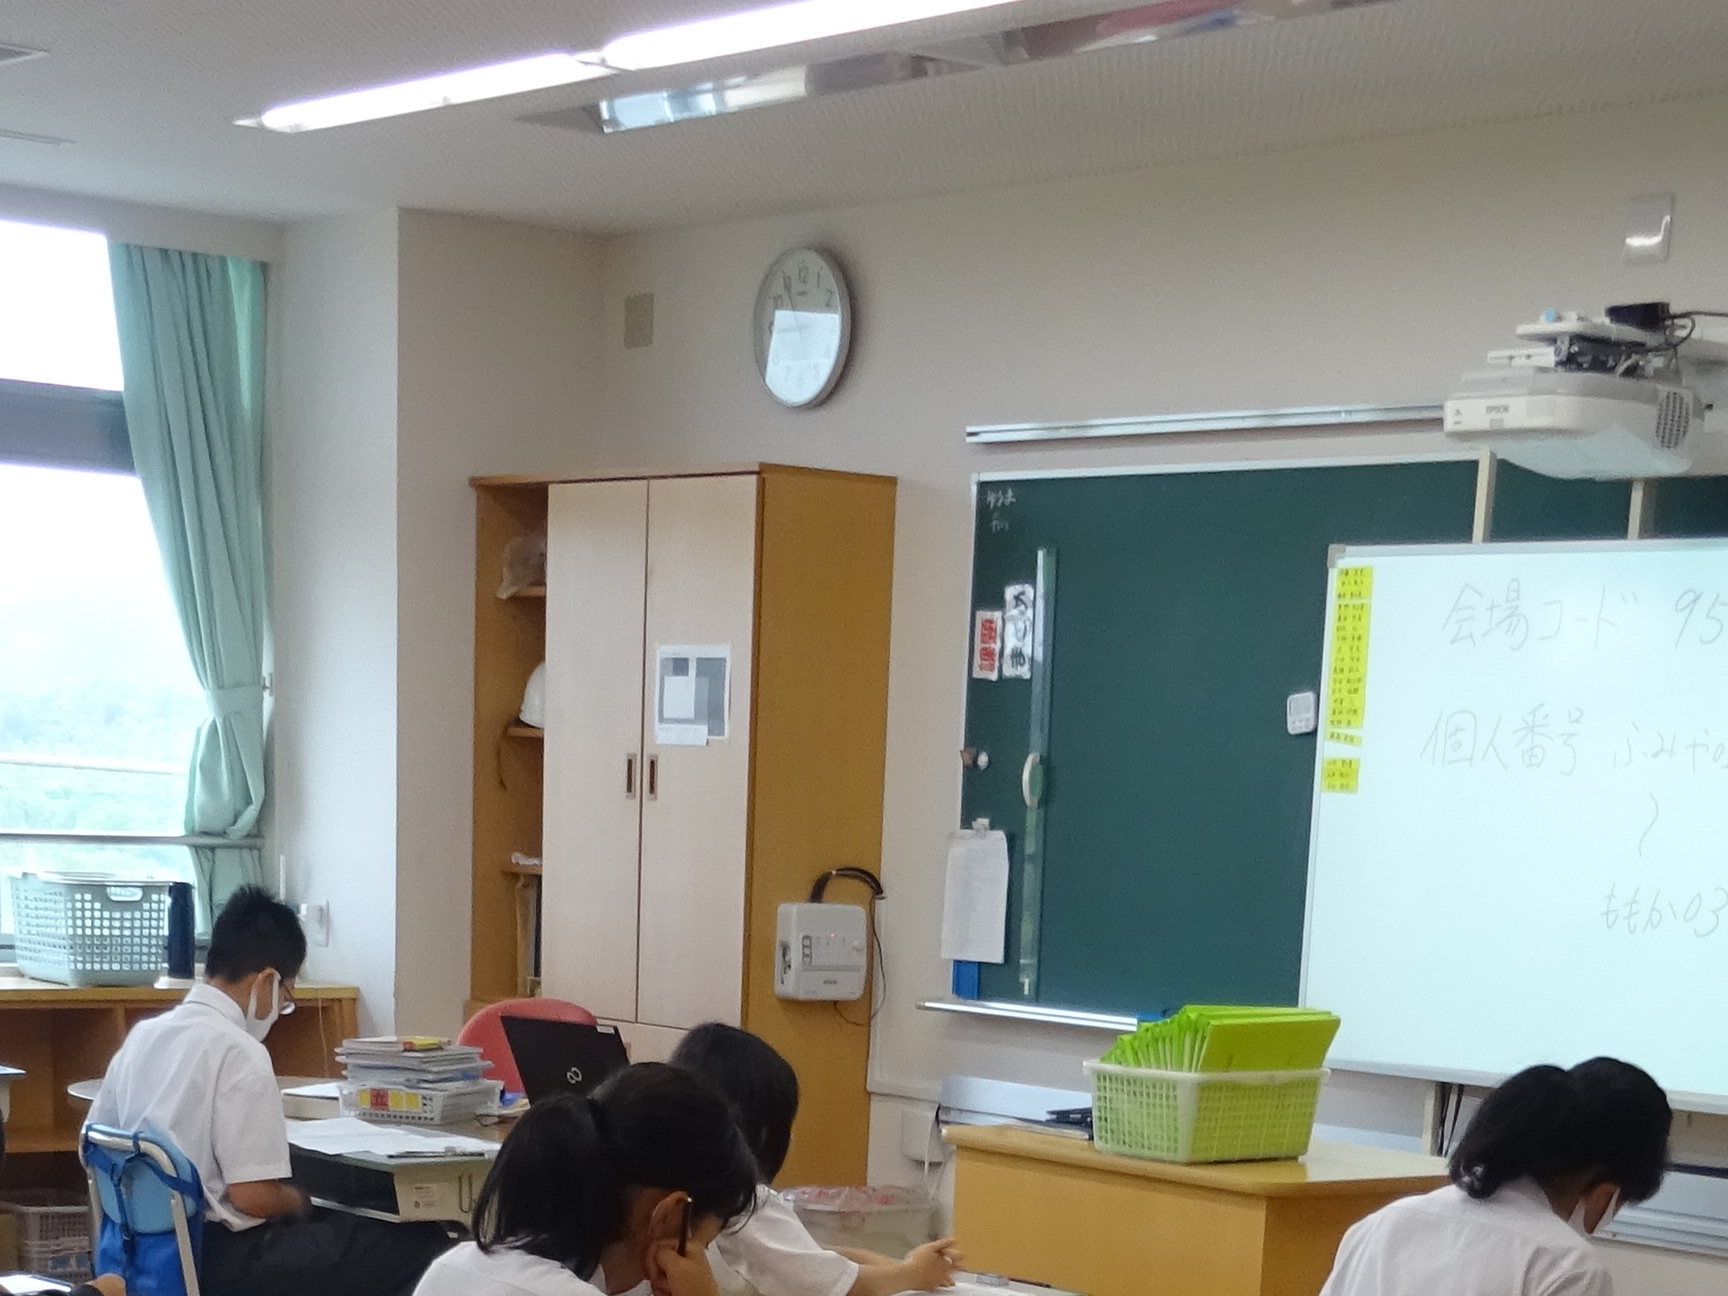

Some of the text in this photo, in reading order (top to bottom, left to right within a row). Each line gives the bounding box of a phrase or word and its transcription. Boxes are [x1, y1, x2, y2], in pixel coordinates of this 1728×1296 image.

[1440, 576, 1639, 652] 会場コード
[1419, 701, 1585, 777] 個人番号
